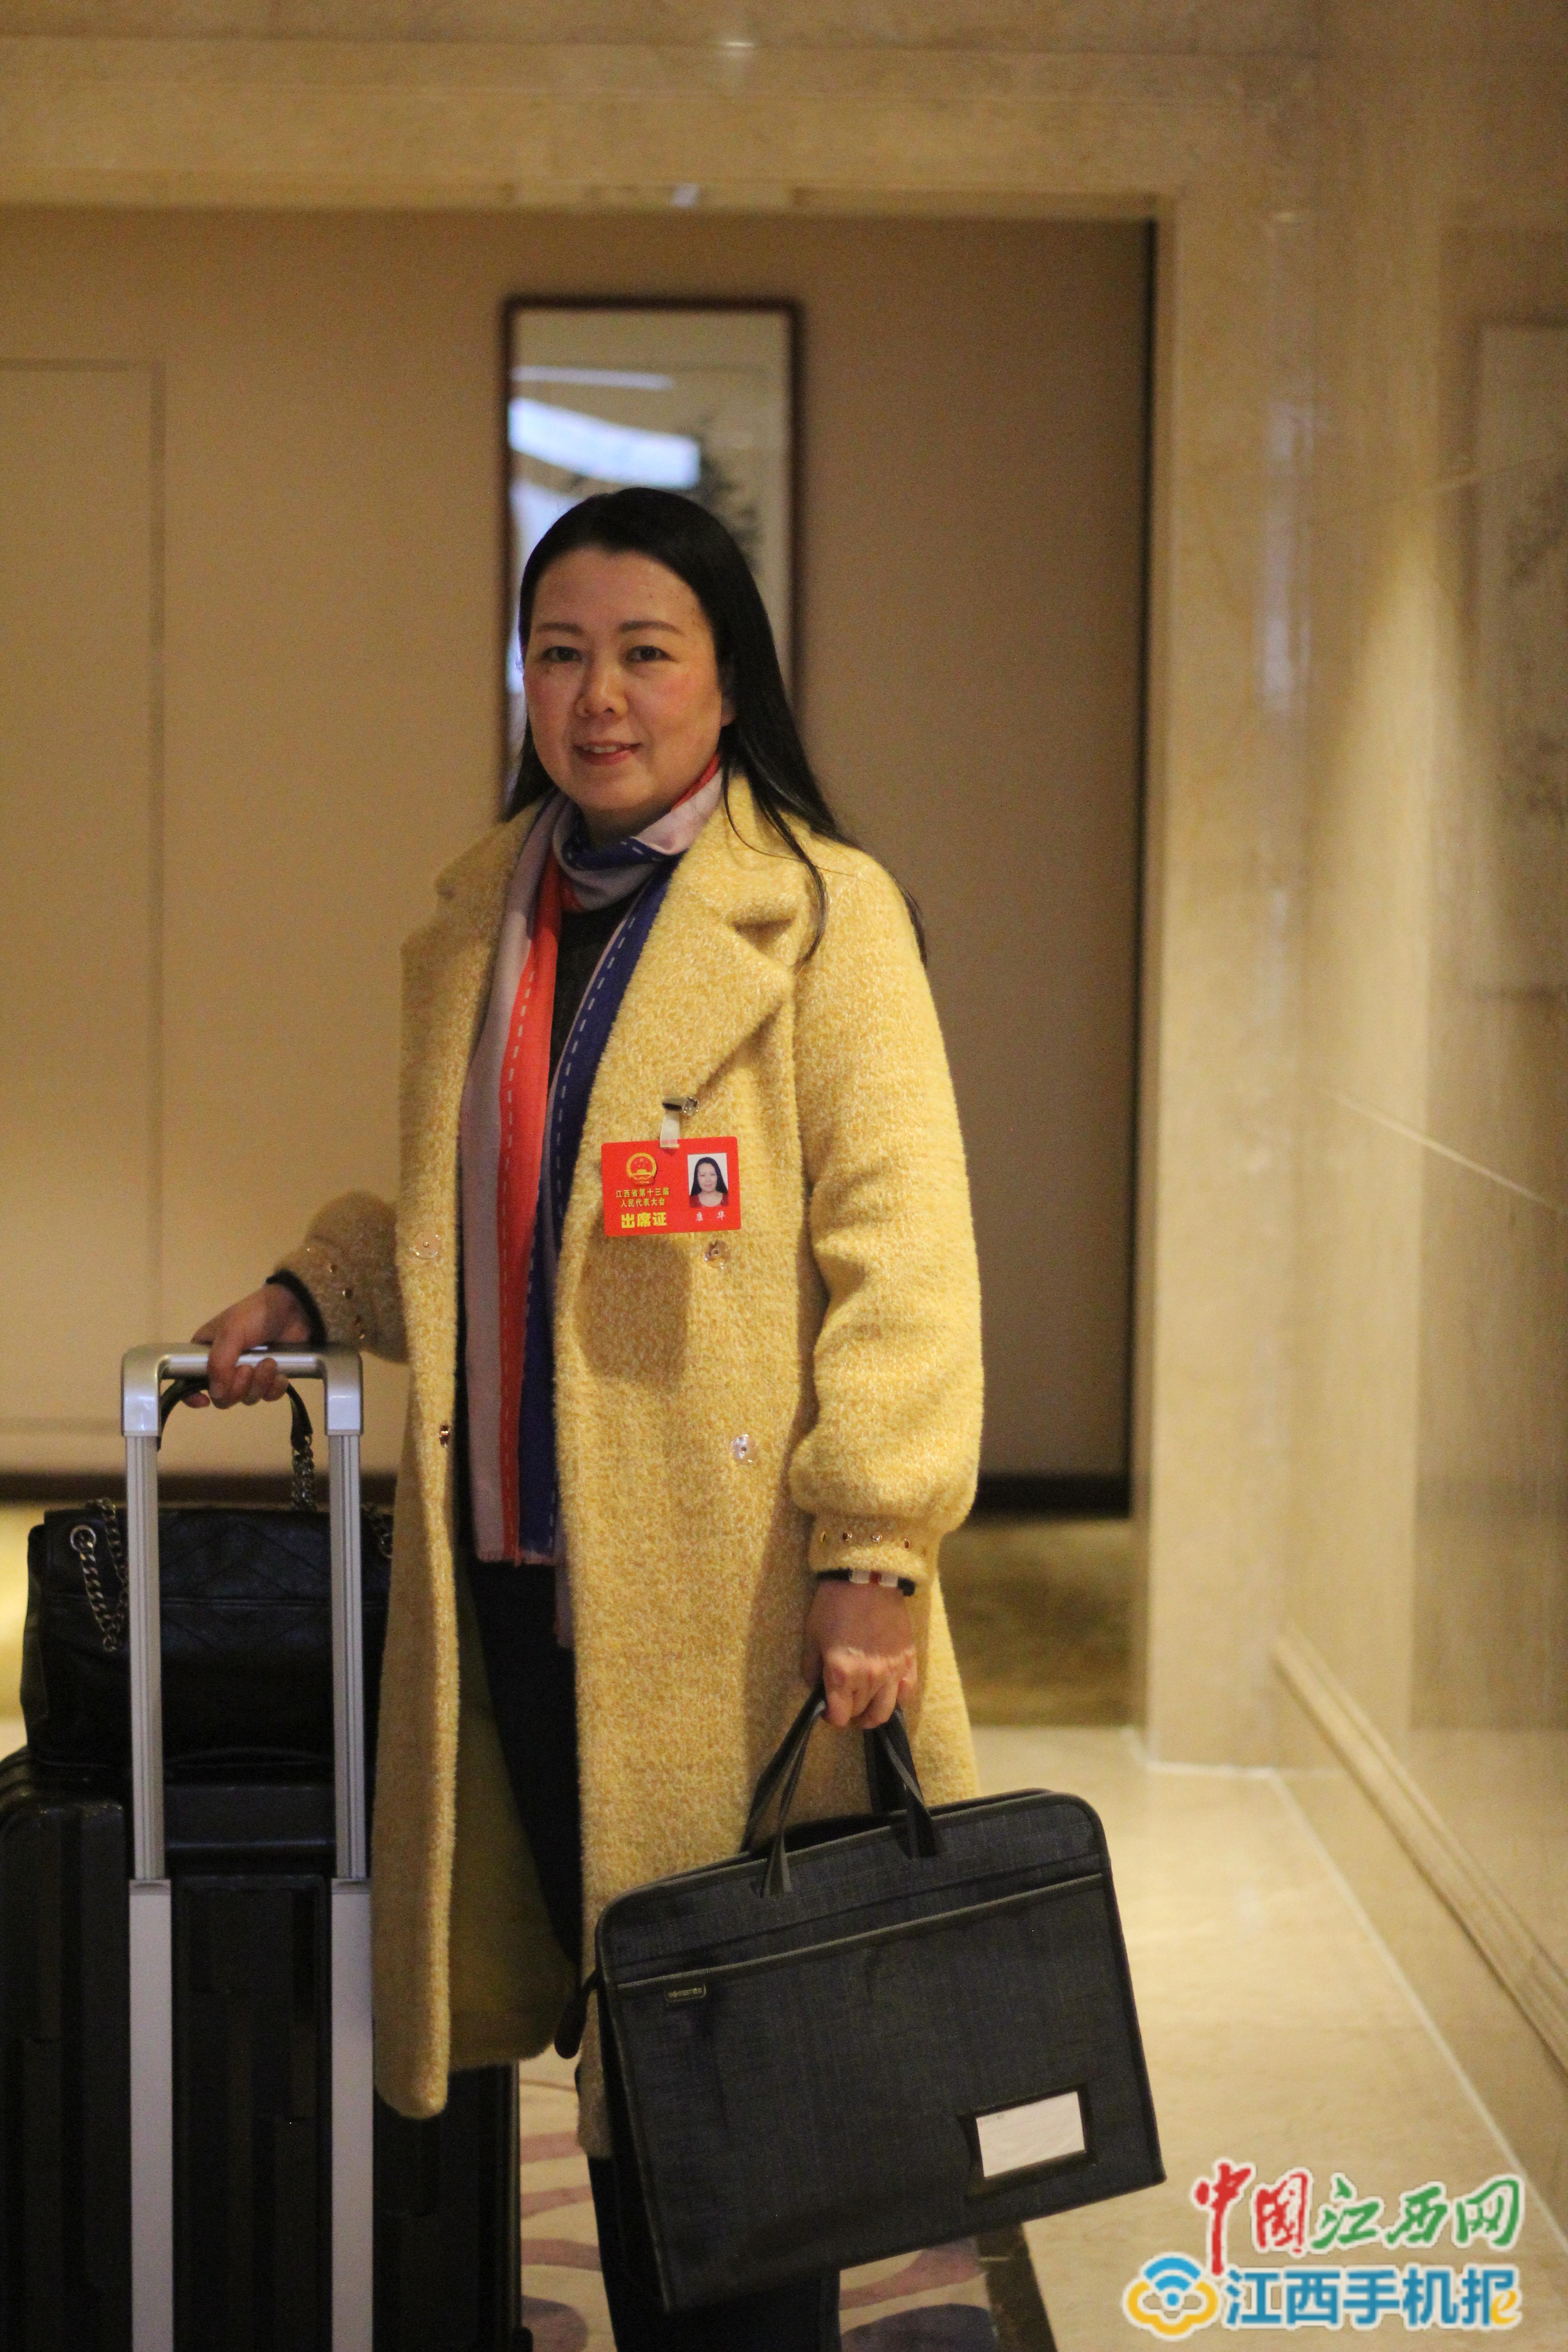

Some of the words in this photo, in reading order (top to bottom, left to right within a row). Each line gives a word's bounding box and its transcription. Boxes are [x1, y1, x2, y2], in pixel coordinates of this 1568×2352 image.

[616, 1187, 670, 1198] 江西省第十三届
[621, 1197, 666, 1207] 人民代表大会
[621, 1211, 667, 1229] 出席证
